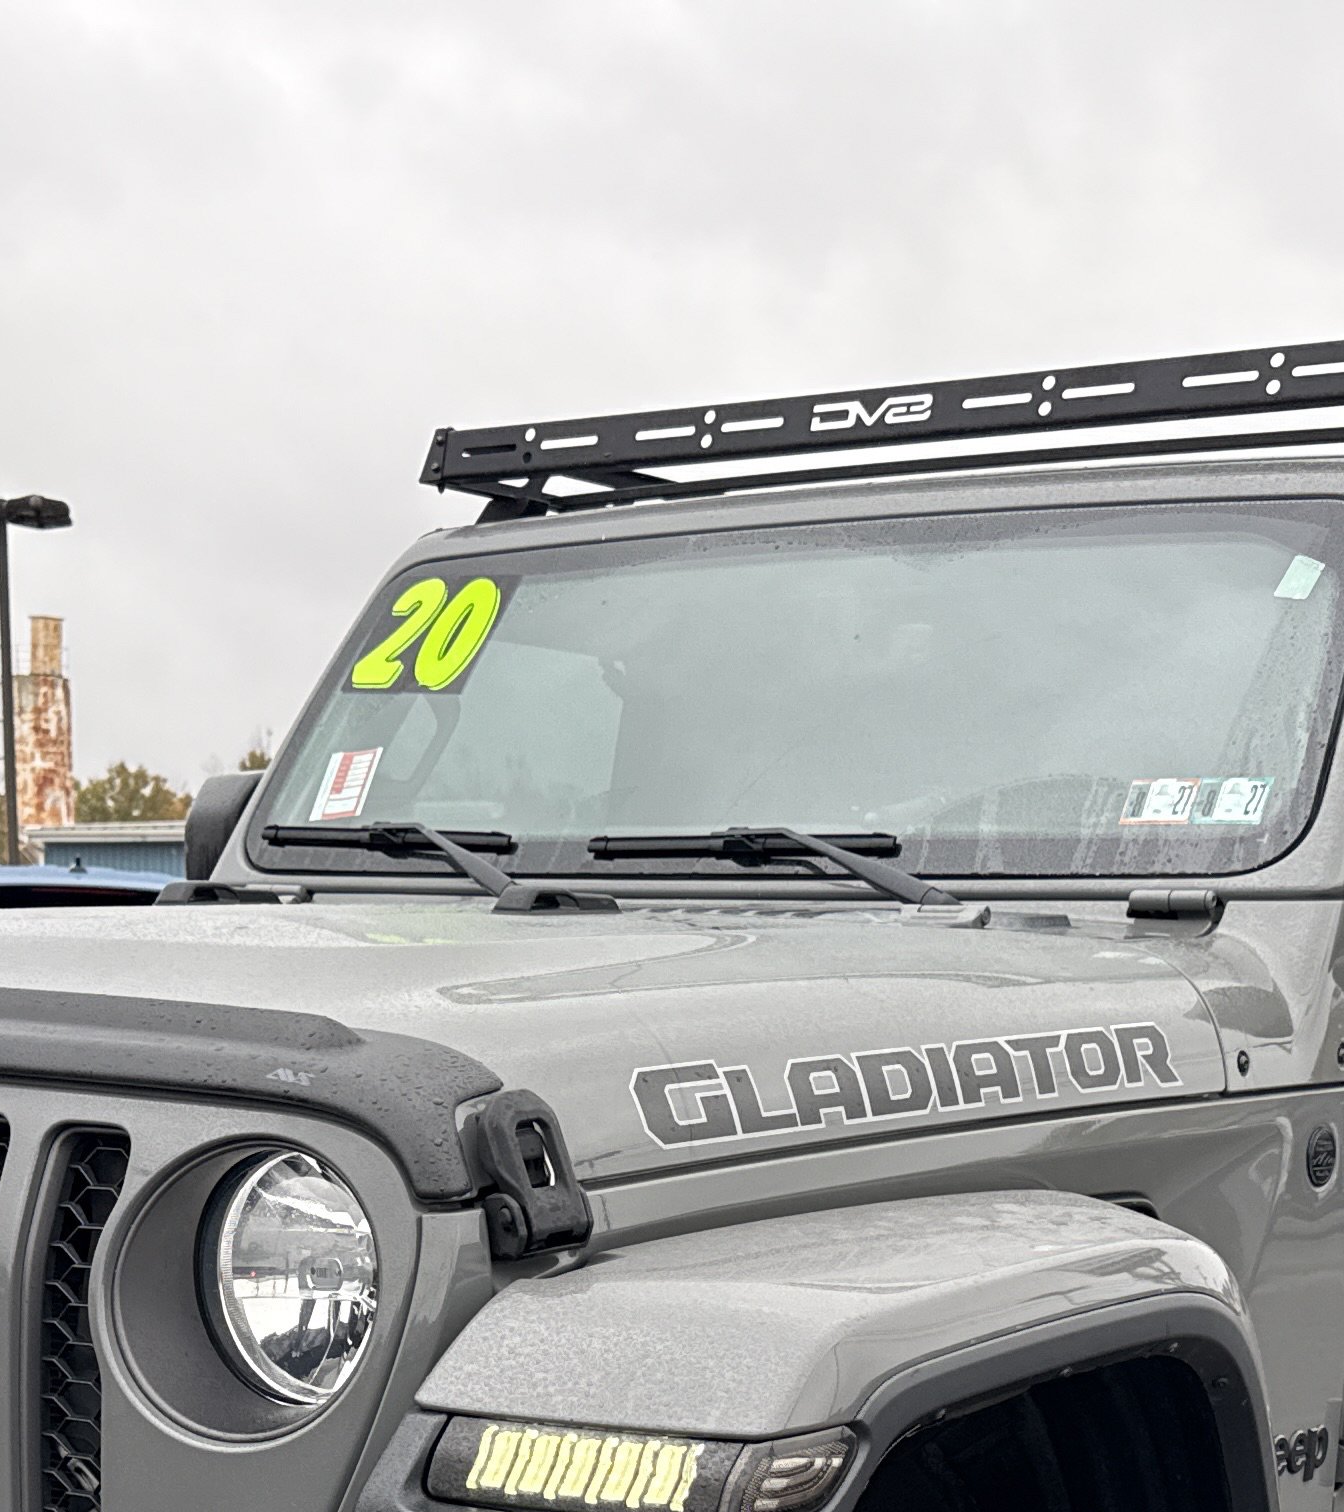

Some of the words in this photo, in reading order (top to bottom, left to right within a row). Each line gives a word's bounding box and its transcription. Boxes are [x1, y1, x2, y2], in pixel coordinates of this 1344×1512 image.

[351, 577, 501, 691] 20
[1171, 784, 1195, 816] 27
[1243, 783, 1267, 816] 27
[628, 1021, 1184, 1150] GLADIATOR
[1273, 1424, 1329, 1483] eep
